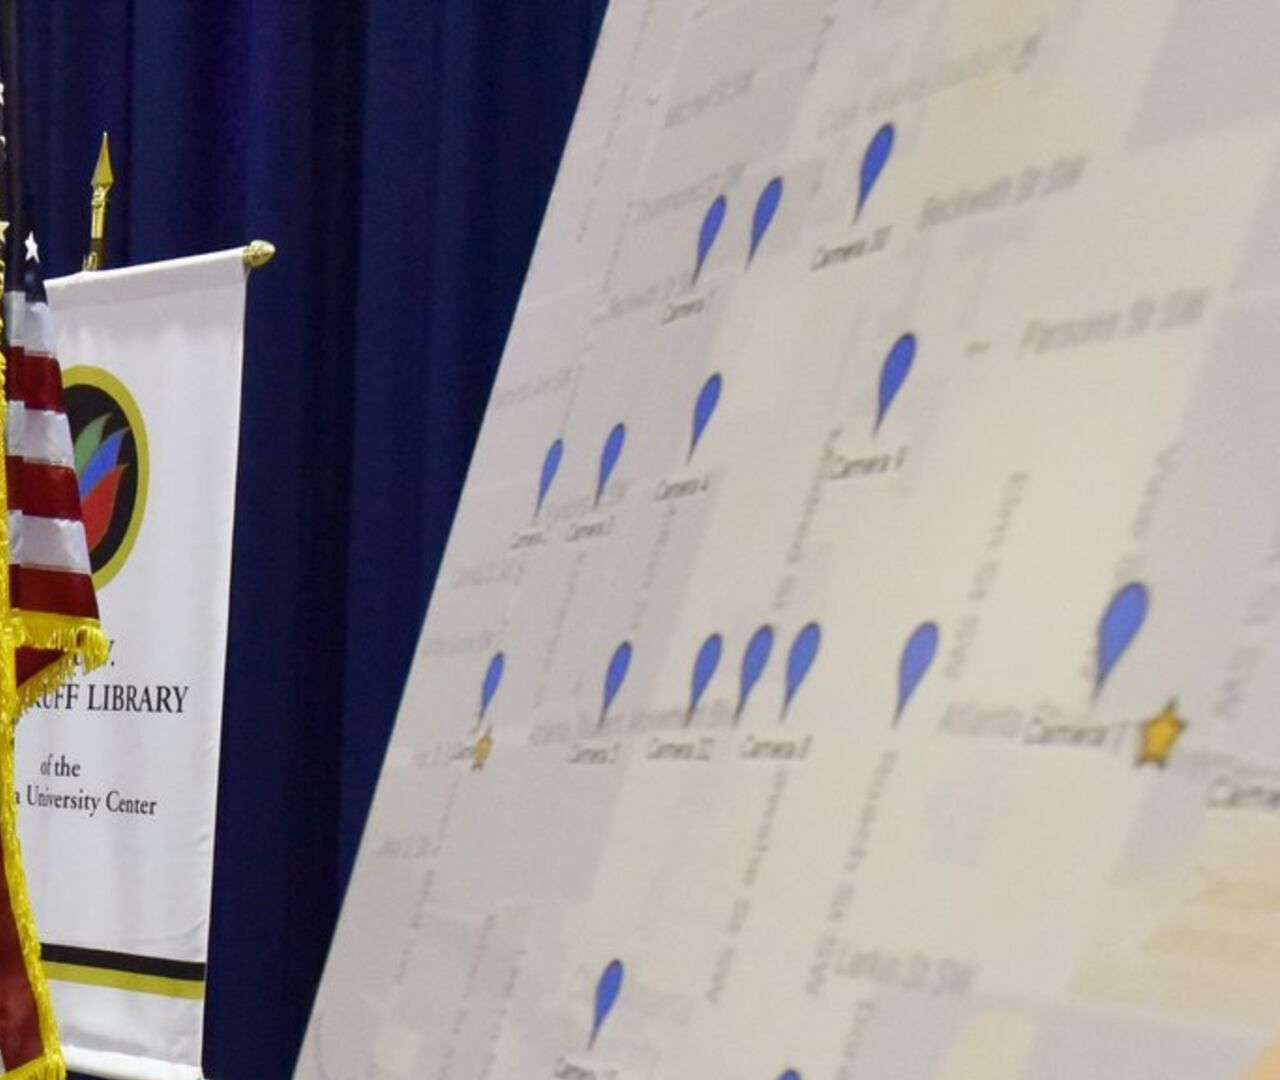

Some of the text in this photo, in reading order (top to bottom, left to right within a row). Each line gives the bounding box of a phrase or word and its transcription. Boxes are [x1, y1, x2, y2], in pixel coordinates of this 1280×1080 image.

[86, 683, 189, 714] LIBRARY
[40, 753, 81, 778] of the
[26, 784, 101, 817] University
[106, 790, 158, 816] Center
